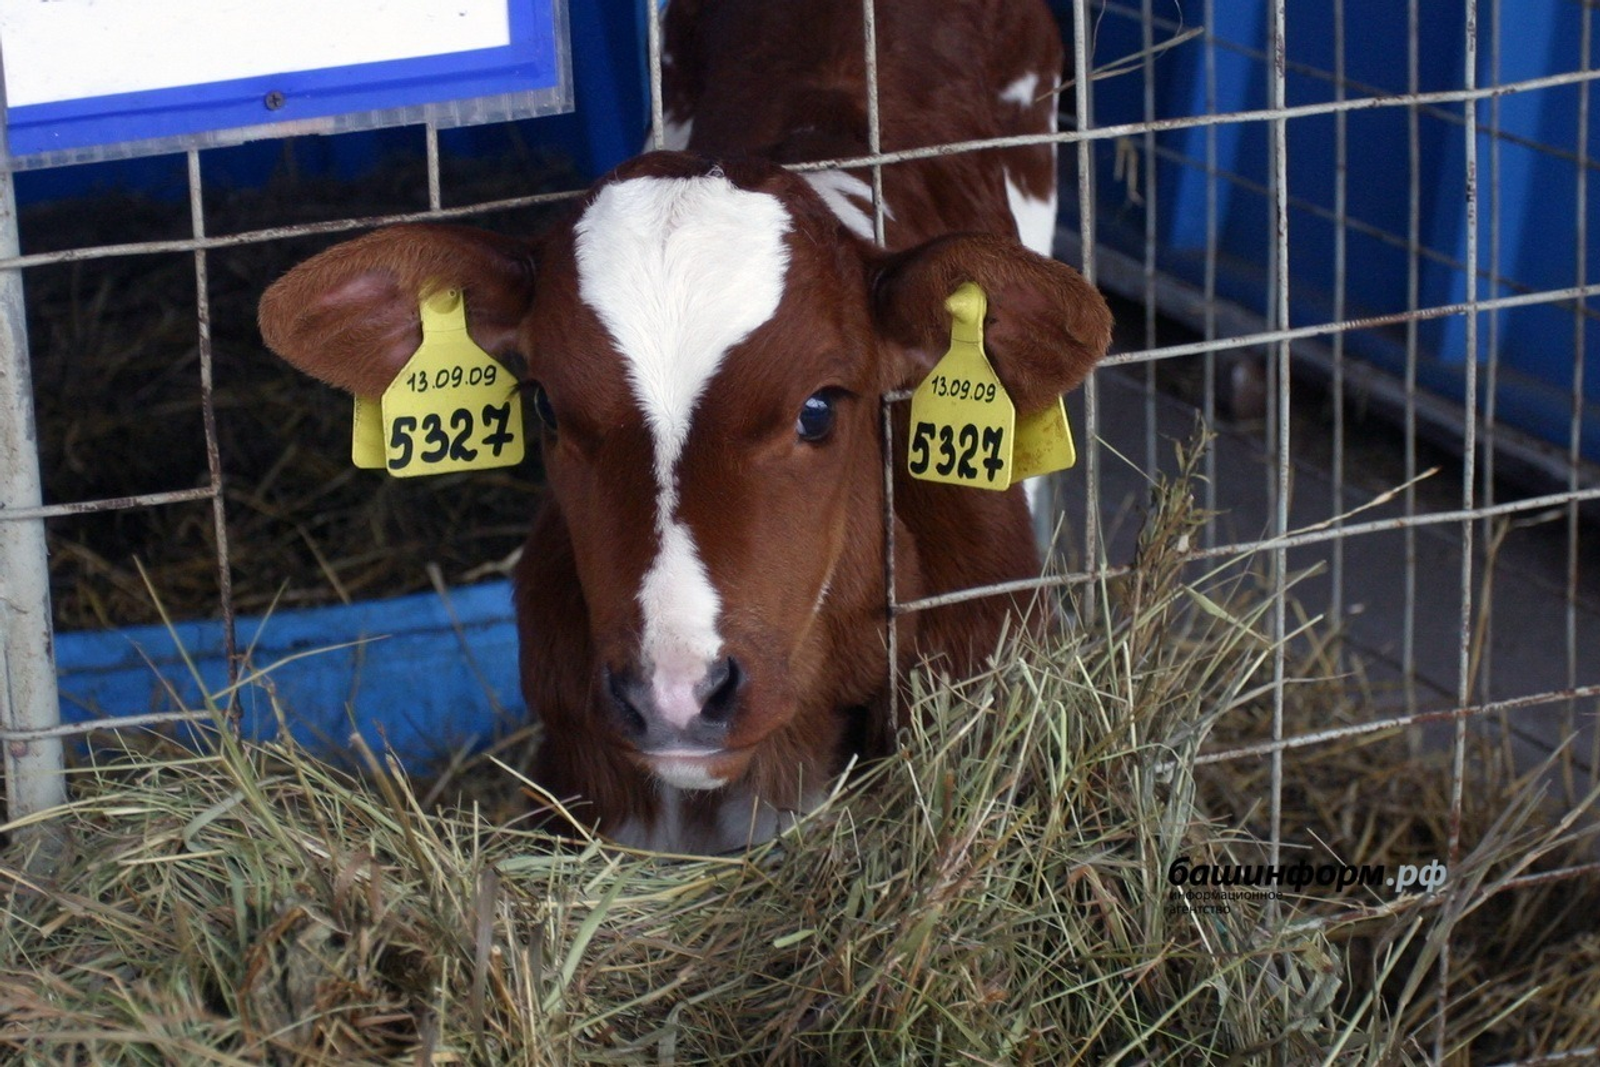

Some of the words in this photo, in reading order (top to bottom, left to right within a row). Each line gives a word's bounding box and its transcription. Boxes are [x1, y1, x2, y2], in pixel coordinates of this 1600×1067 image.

[407, 364, 497, 393] 13.09.09
[931, 375, 996, 403] 13.09.09
[388, 401, 515, 470] 5327
[909, 421, 1004, 482] 5327
